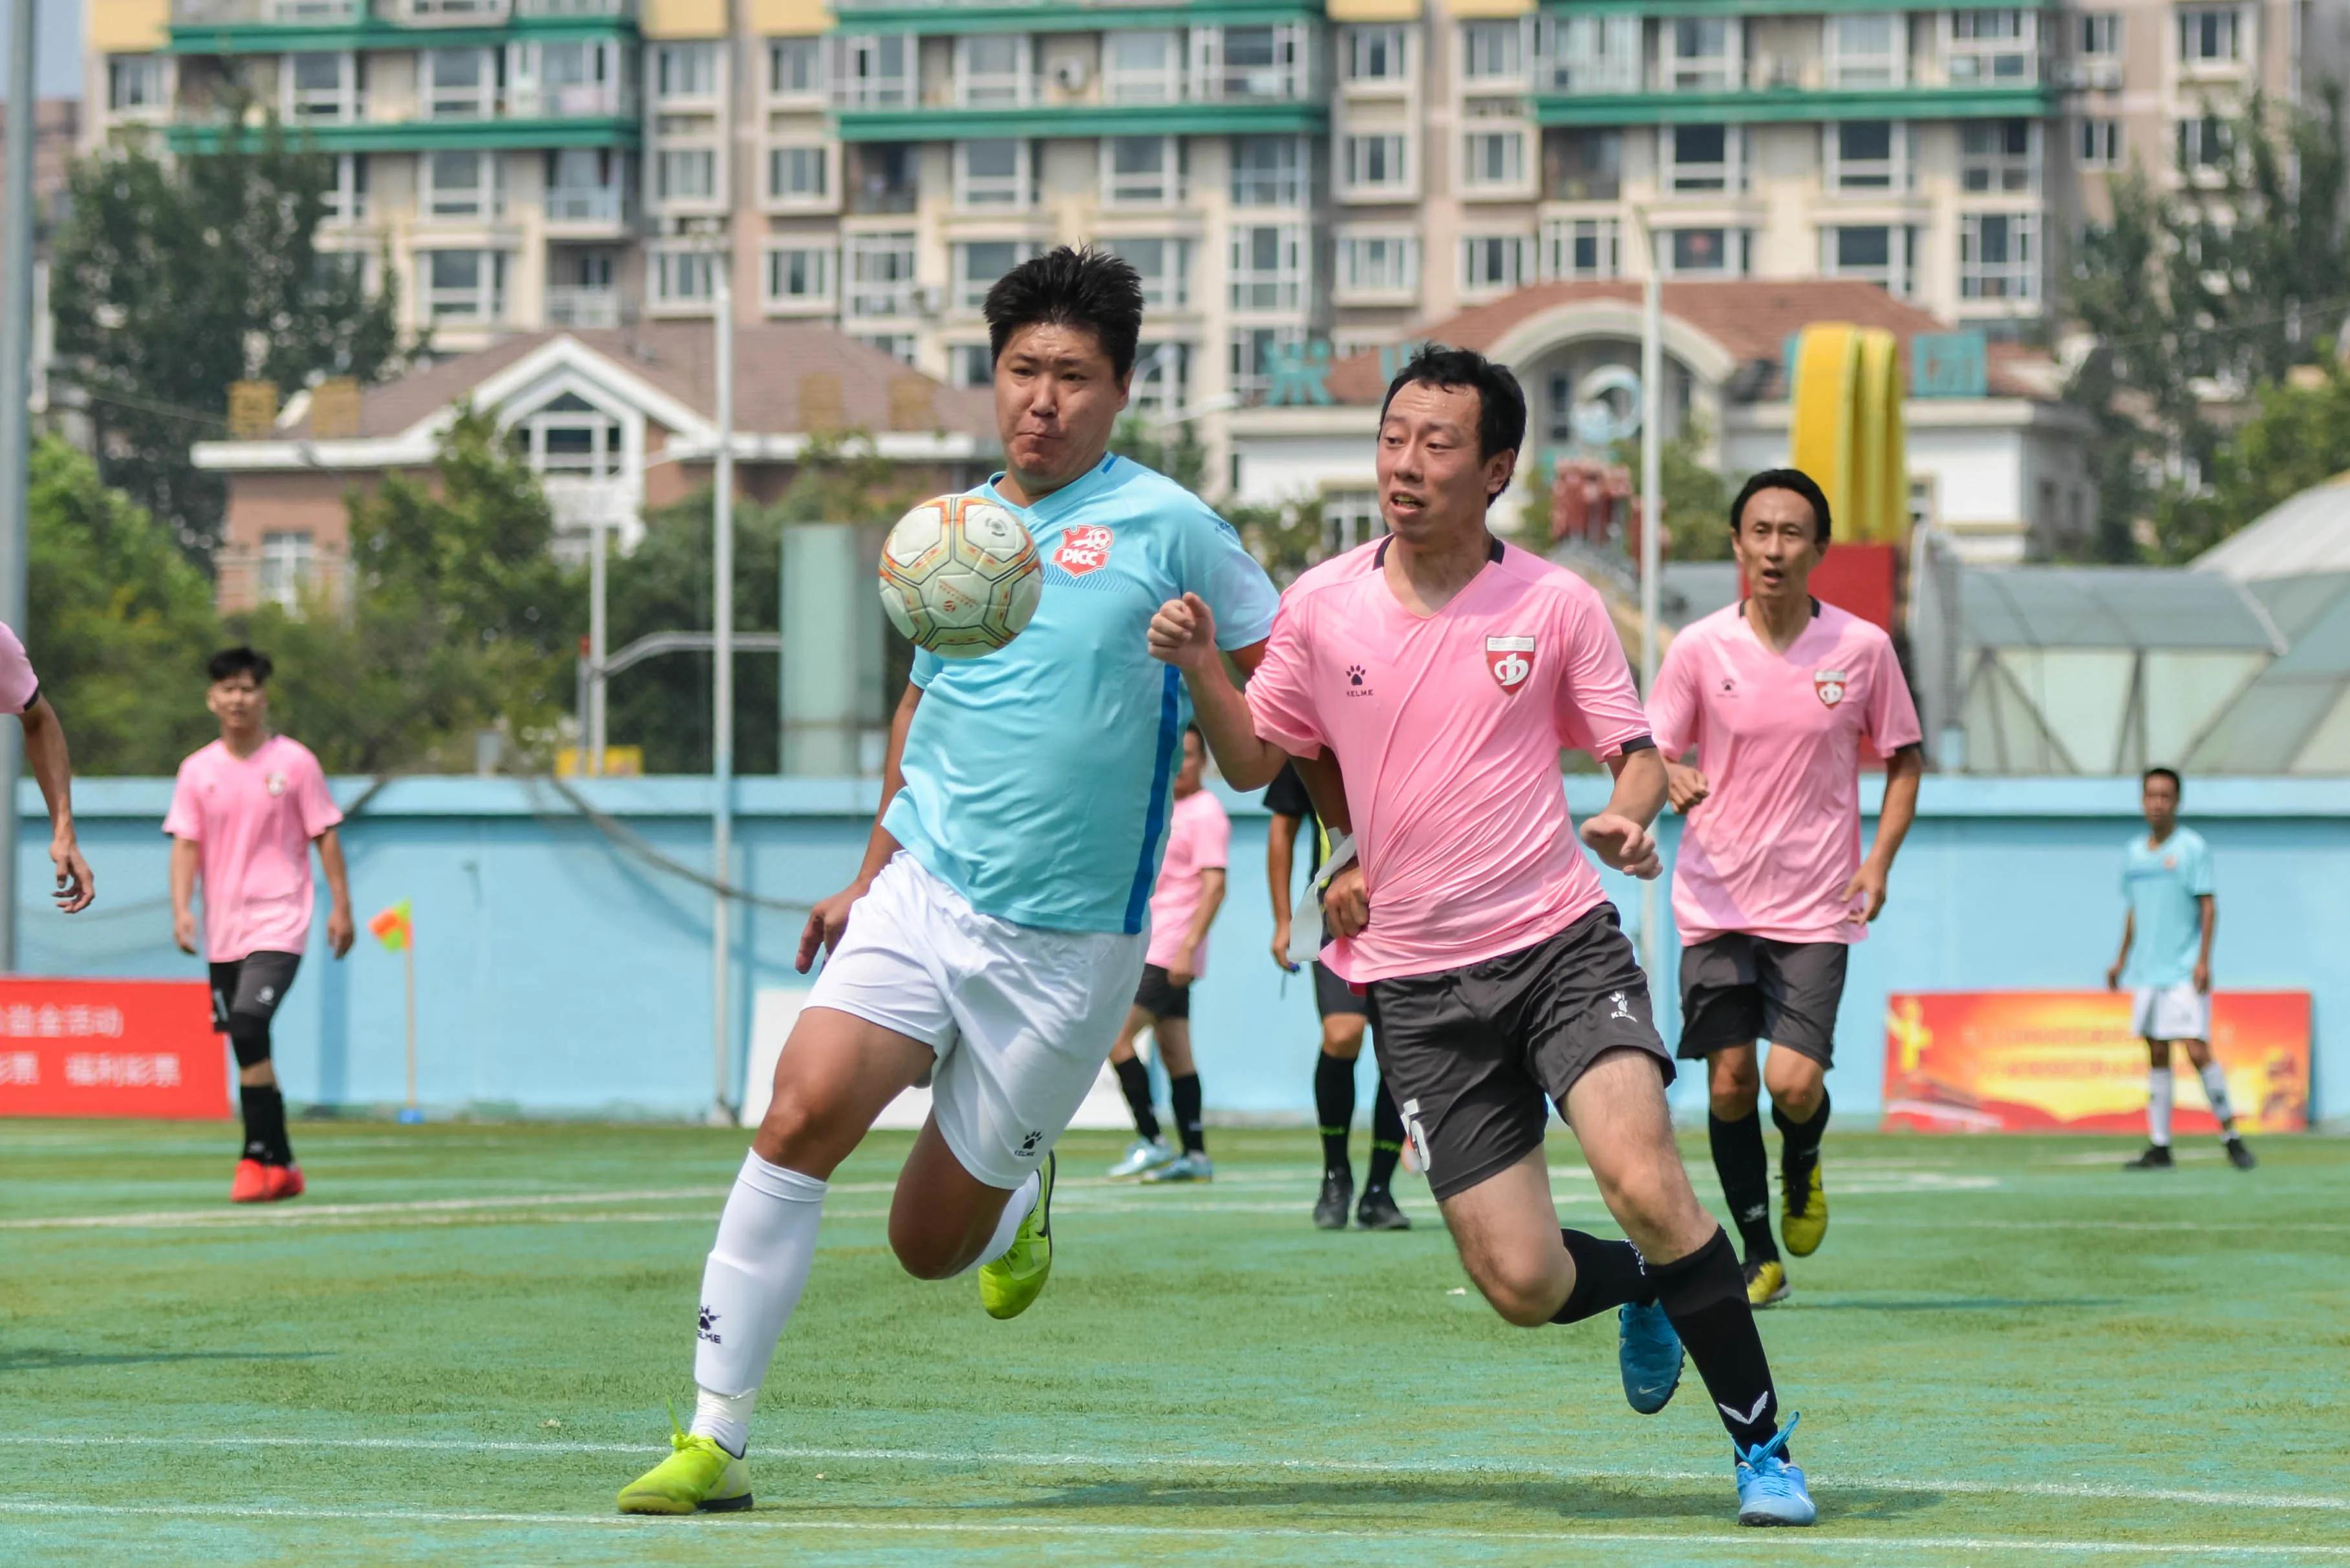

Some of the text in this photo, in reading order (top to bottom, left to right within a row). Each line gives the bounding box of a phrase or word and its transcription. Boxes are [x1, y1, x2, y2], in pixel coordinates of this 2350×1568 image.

[1061, 548, 1098, 566] PICC
[1346, 689, 1374, 697] KELME
[0, 1002, 125, 1038] 益金活动
